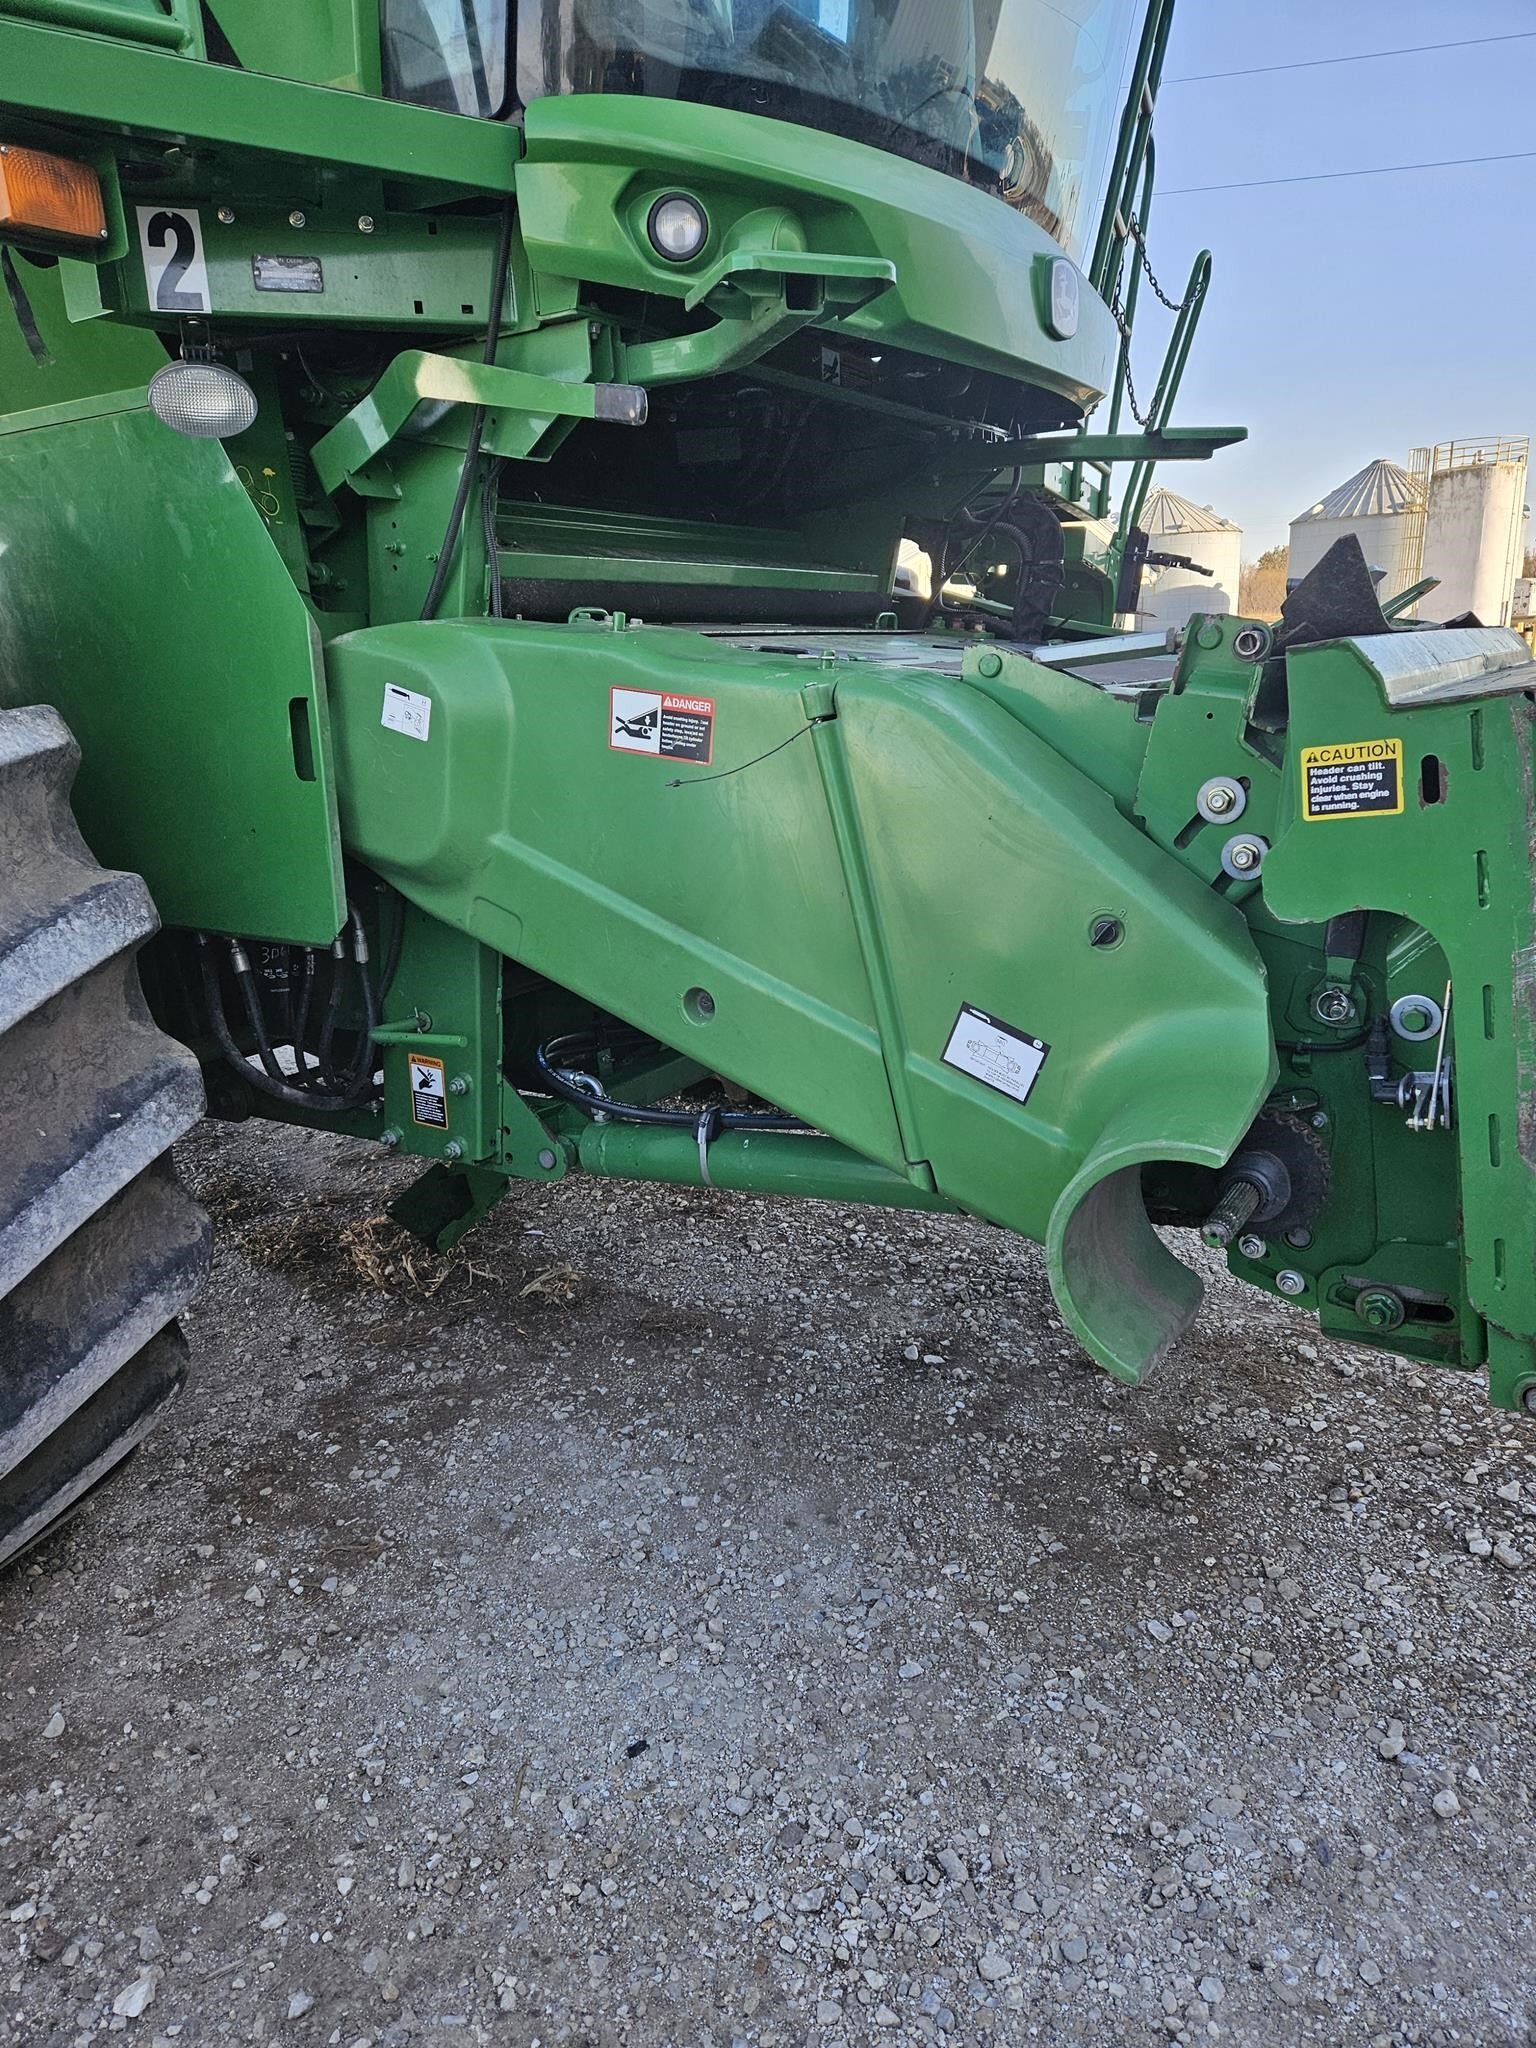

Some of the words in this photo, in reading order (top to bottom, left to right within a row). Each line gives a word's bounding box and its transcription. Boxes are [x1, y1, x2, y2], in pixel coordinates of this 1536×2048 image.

[147, 211, 204, 311] 2
[672, 698, 711, 713] DANGER
[1320, 743, 1396, 762] CAUTION
[1310, 766, 1344, 776] Header
[1346, 764, 1366, 772] can
[1368, 762, 1386, 770] tilt.
[1310, 776, 1338, 785] Avoid
[1340, 772, 1382, 782] crushing
[1310, 785, 1350, 794] injuries.
[1352, 782, 1374, 791] Stay
[1310, 794, 1332, 802] clear
[1334, 792, 1358, 800] when
[1359, 789, 1390, 800] engine
[1322, 802, 1360, 810] running.
[416, 1058, 442, 1068] WARNING
